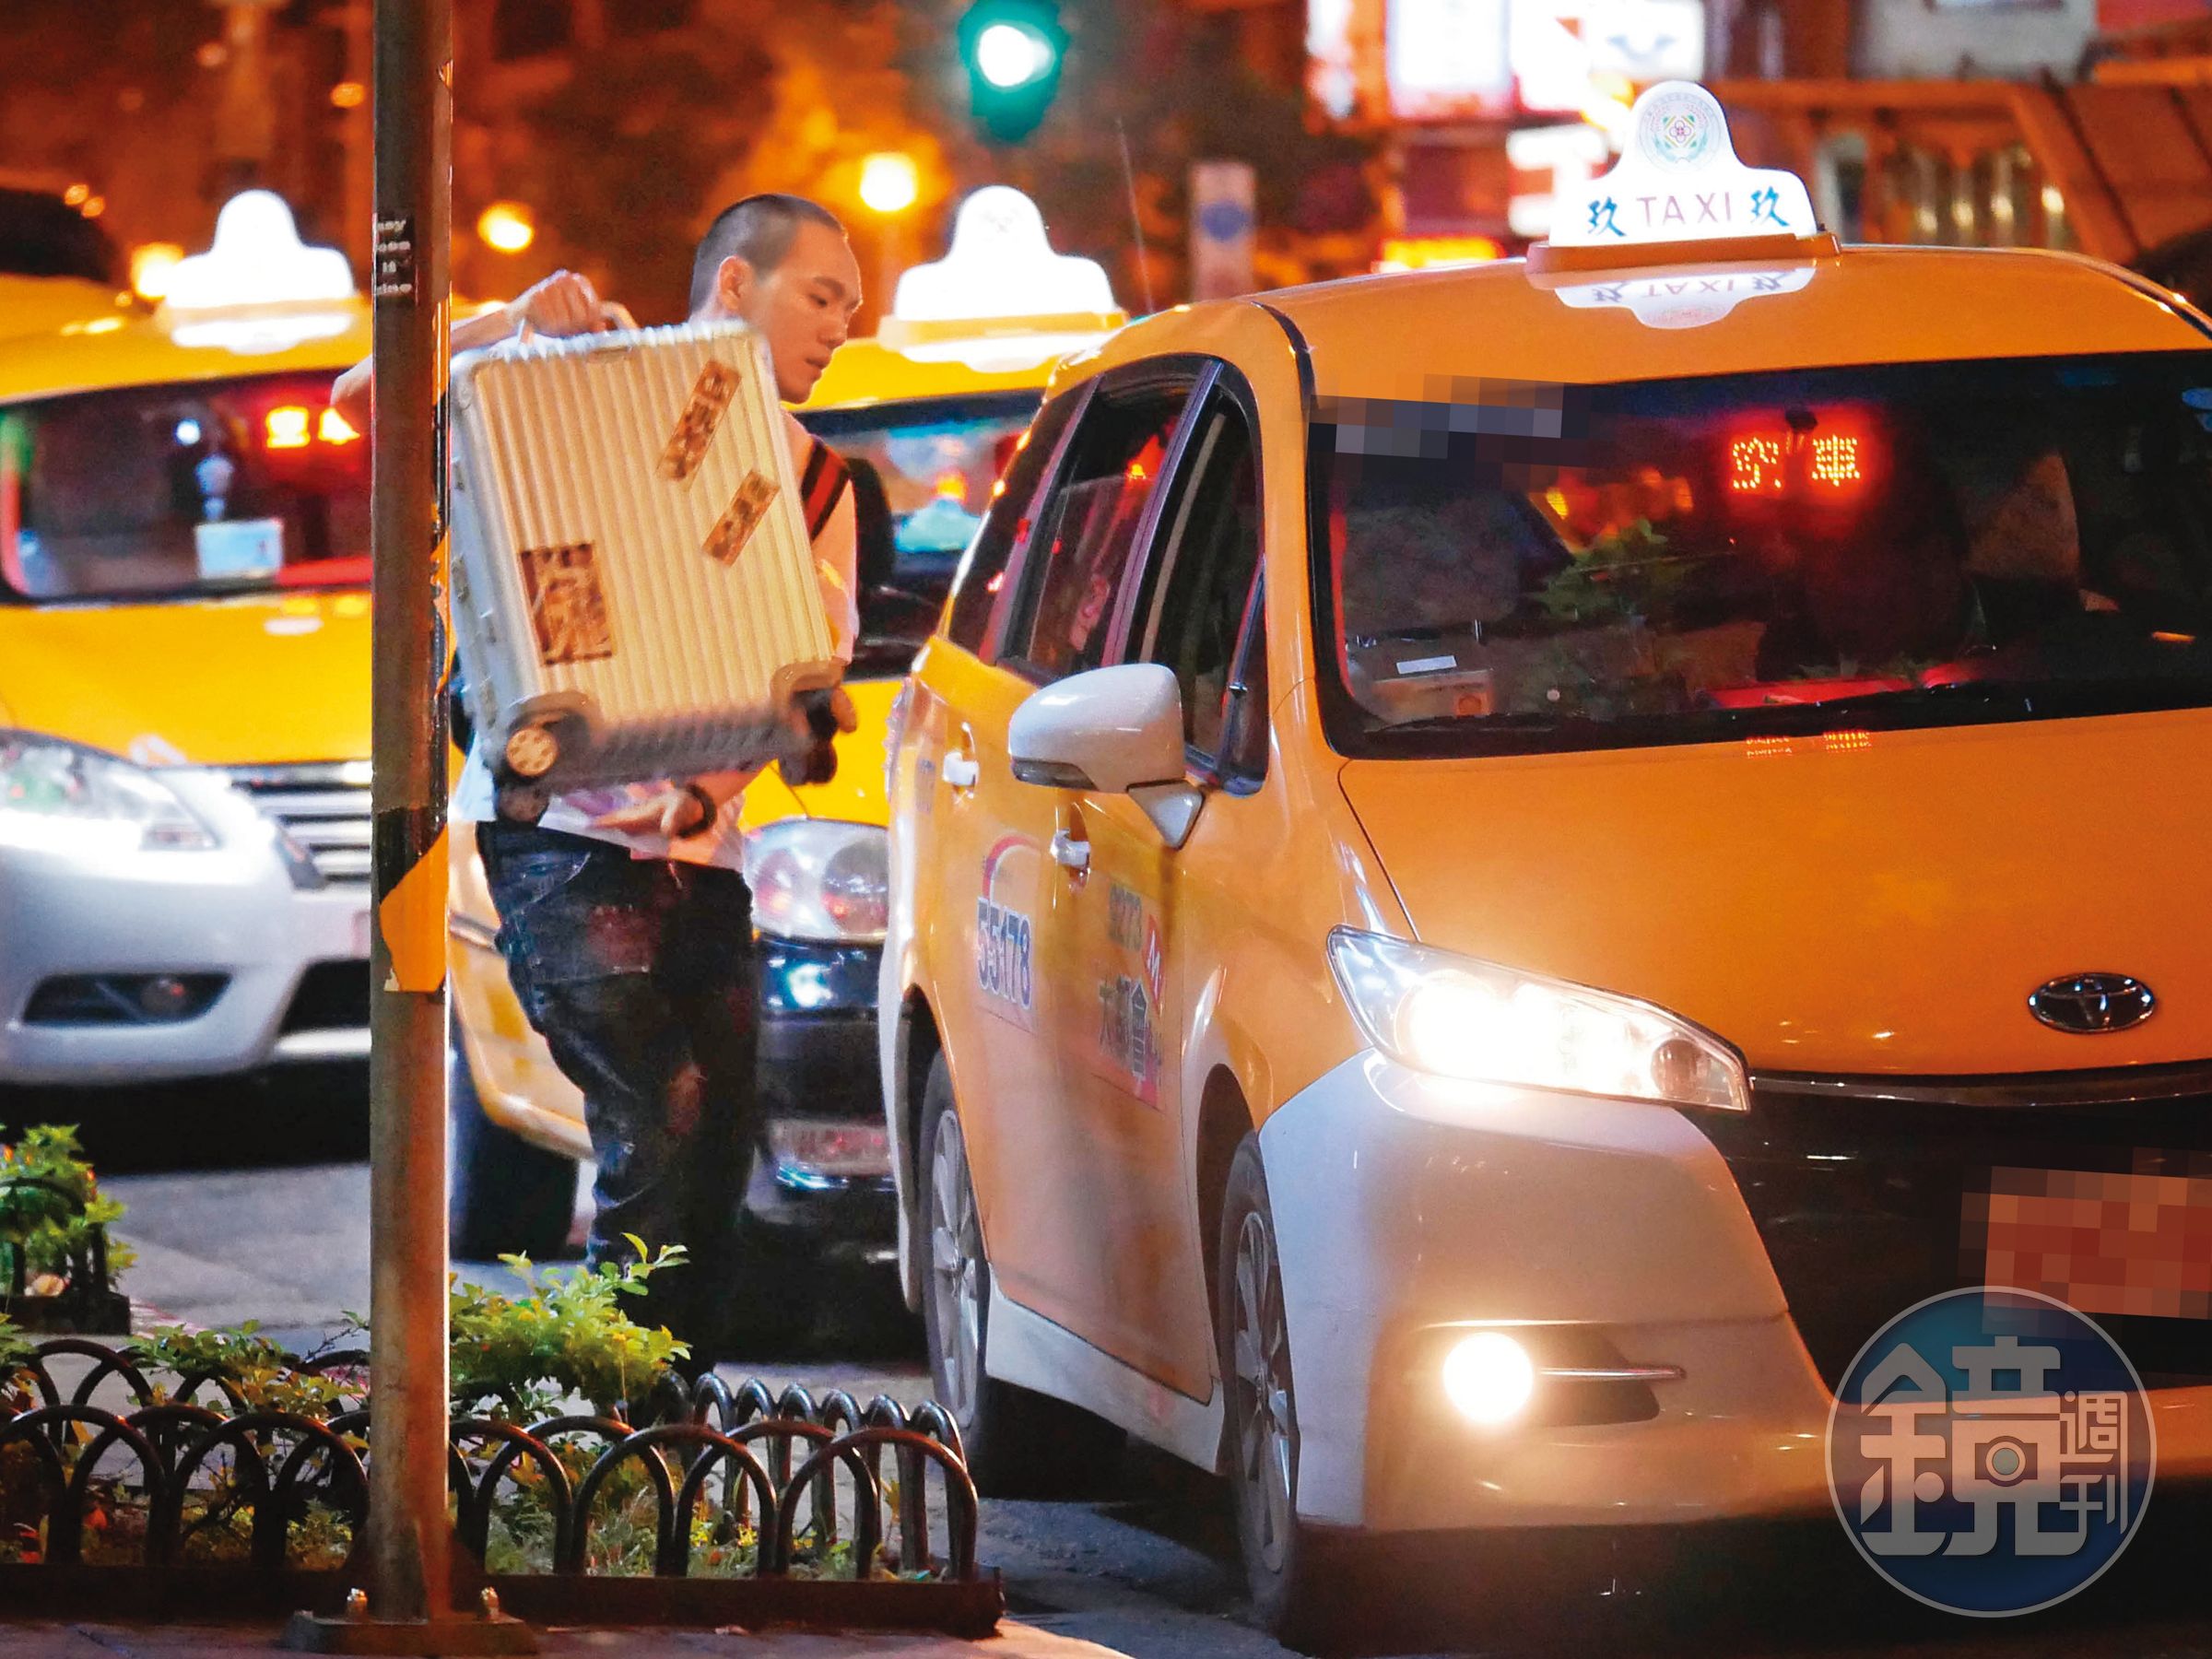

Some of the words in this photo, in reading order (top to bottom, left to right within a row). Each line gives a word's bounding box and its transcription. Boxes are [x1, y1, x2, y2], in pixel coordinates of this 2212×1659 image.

[1586, 195, 1628, 238] 玖
[1635, 191, 1733, 229] TAXI
[1750, 185, 1791, 228] 玖
[976, 896, 1032, 1010] 55178
